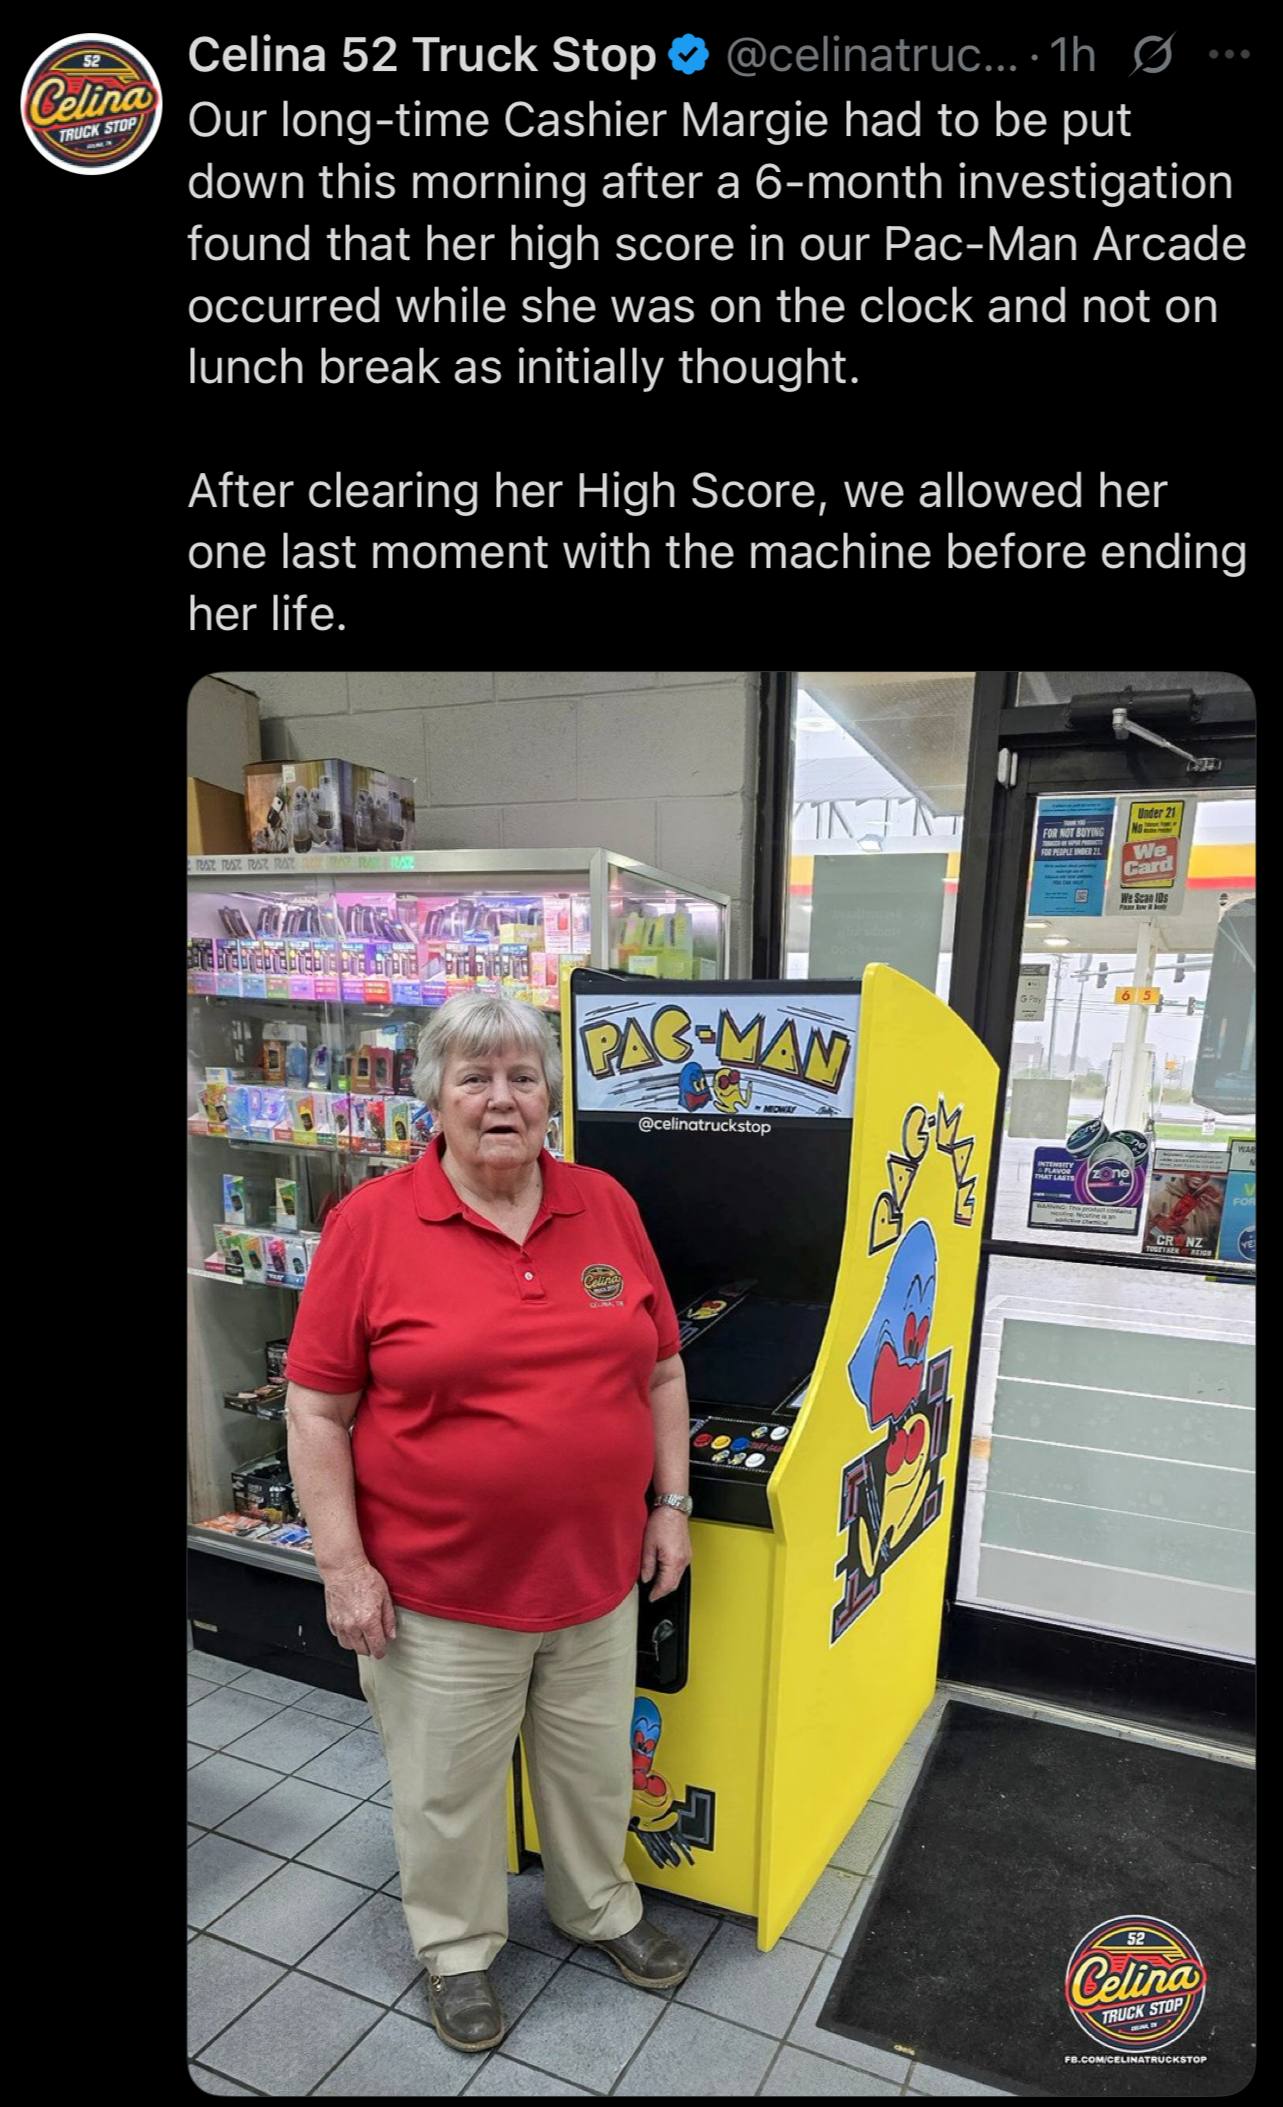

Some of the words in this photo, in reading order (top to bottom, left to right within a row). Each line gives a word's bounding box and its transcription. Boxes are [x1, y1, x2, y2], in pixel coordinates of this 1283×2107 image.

[1138, 808, 1163, 818] Under
[1165, 807, 1176, 818] 21
[1043, 828, 1058, 839] FOR
[1060, 828, 1074, 838] NOT
[1076, 827, 1104, 838] BUYING
[1041, 848, 1052, 856] FOR
[1053, 848, 1072, 856] PEOPLE
[1133, 843, 1167, 860] We
[1124, 855, 1173, 876] Card
[1121, 893, 1133, 903] We
[1134, 893, 1153, 903] Scan
[1155, 893, 1168, 903] IDs
[1121, 991, 1131, 1001] 6
[1143, 990, 1152, 1001] 5
[580, 1004, 851, 1095] PAC-MAN
[1037, 1161, 1074, 1169] INTENSITY
[868, 1091, 977, 1256] PAC-MAN
[1092, 1167, 1130, 1181] zone
[584, 1274, 622, 1289] Celina
